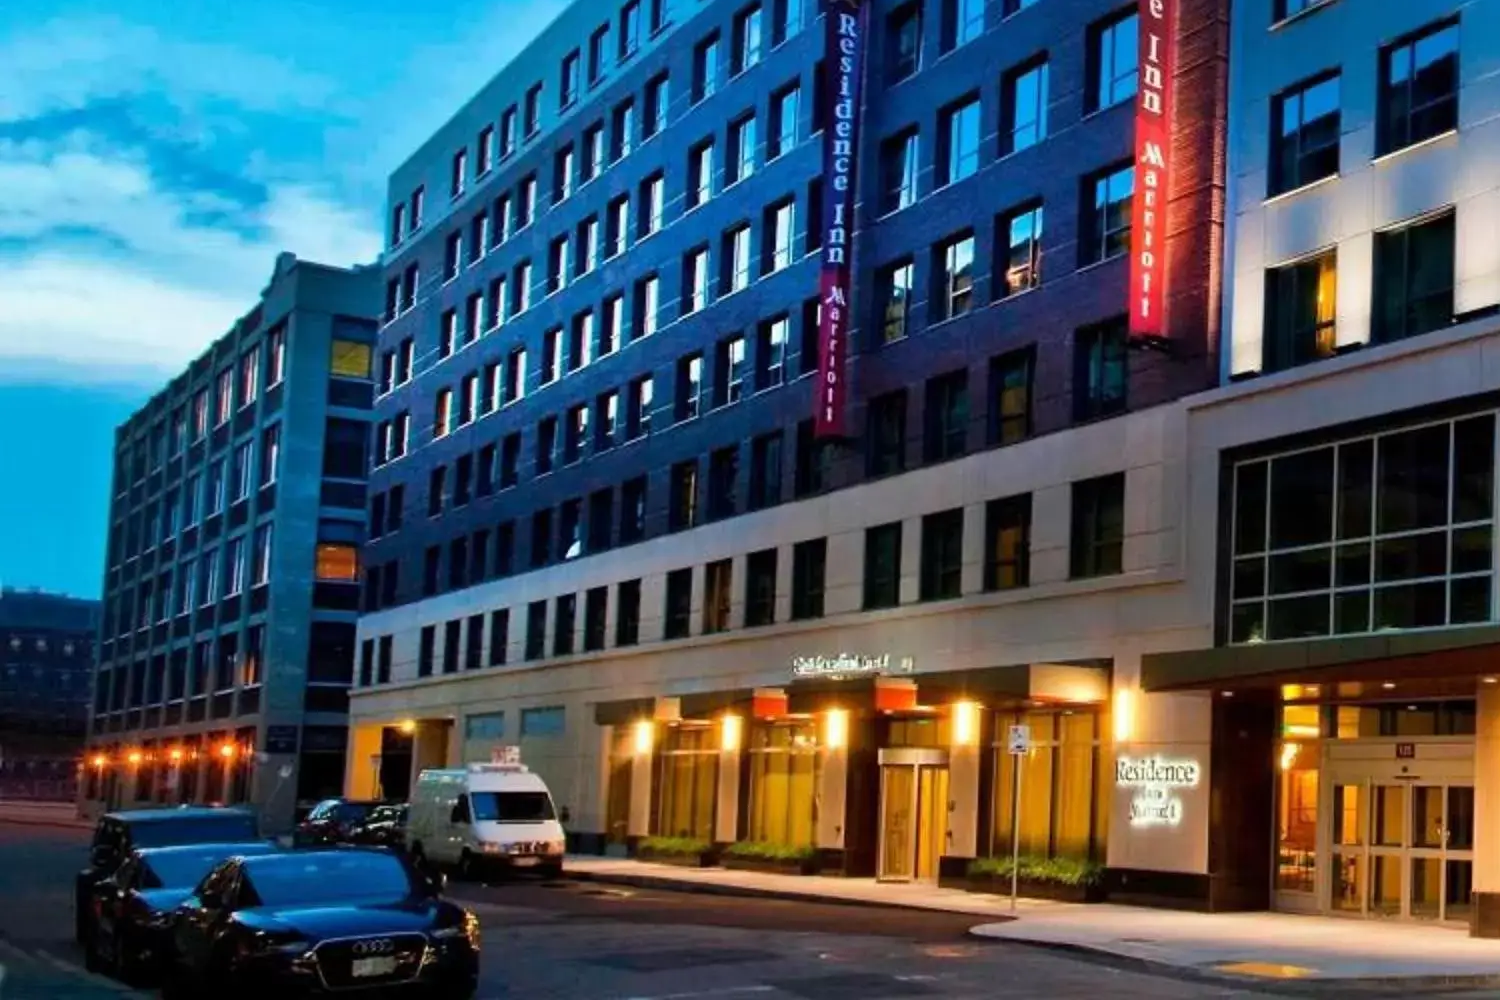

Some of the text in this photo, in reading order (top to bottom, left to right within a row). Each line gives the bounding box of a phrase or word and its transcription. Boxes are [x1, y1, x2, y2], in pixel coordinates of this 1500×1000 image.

[1143, 35, 1162, 114] Inn
[825, 13, 857, 422] Residence Inn Marriott
[1140, 141, 1165, 318] Marriott
[1115, 758, 1195, 782] Residence
